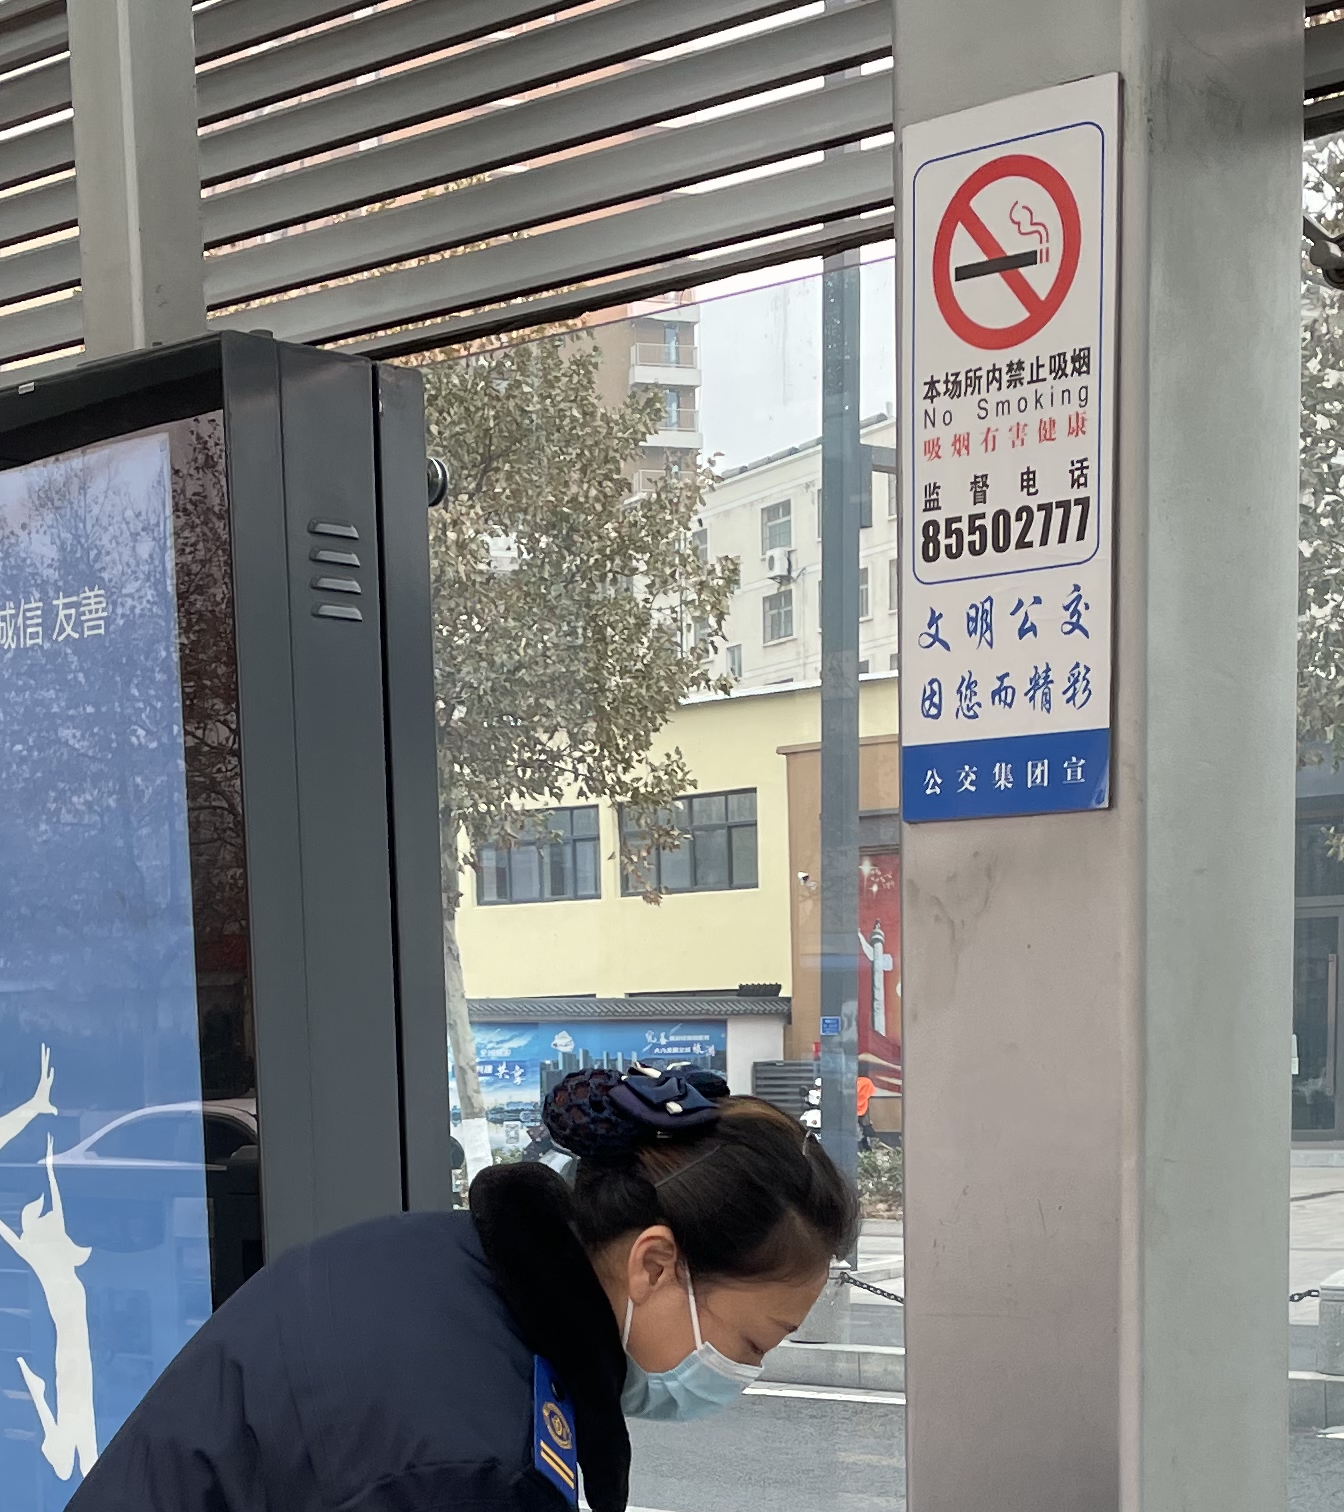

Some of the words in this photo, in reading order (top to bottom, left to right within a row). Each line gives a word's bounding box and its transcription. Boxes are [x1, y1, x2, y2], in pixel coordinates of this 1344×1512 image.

[923, 346, 1091, 403] 本场所内禁止吸烟
[924, 407, 953, 430] No
[977, 384, 1089, 421] Smoking
[923, 410, 1088, 462] 吸烟有害健康
[922, 457, 1090, 512] 监督电话
[921, 496, 1091, 563] 85502777
[918, 584, 1091, 652] 文明公交
[921, 660, 1093, 721] 因您而精彩
[923, 755, 1087, 796] 公交集团宣
